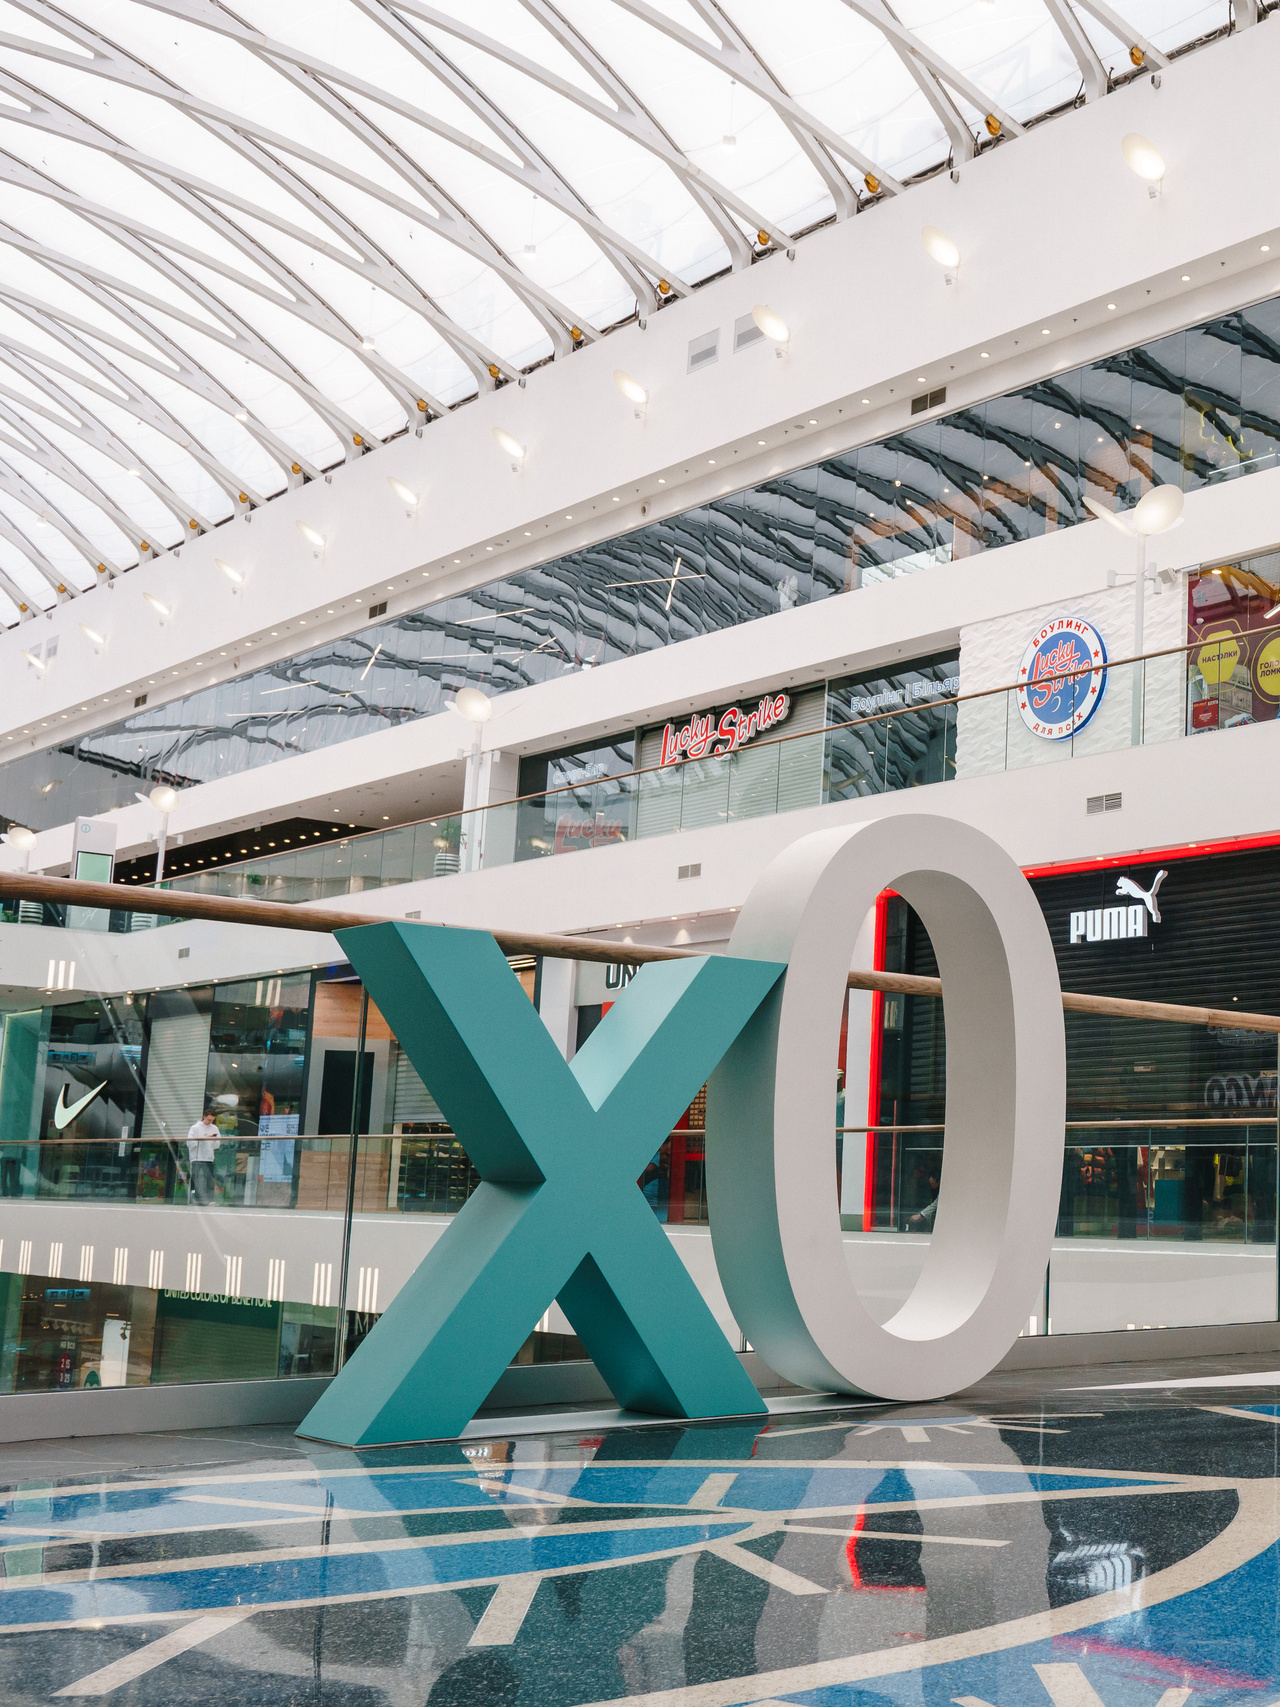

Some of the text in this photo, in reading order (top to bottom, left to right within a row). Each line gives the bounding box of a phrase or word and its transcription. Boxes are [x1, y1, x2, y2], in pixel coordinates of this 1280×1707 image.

[1033, 620, 1088, 648] БОУЛИНГ
[1031, 639, 1080, 689] Lucky
[1202, 650, 1238, 663] НАСТОЛКИ
[851, 688, 903, 713] Боулінг
[659, 694, 790, 772] Lucky Strike
[1033, 722, 1053, 735] ДЛЯ
[1070, 905, 1148, 943] PUMA
